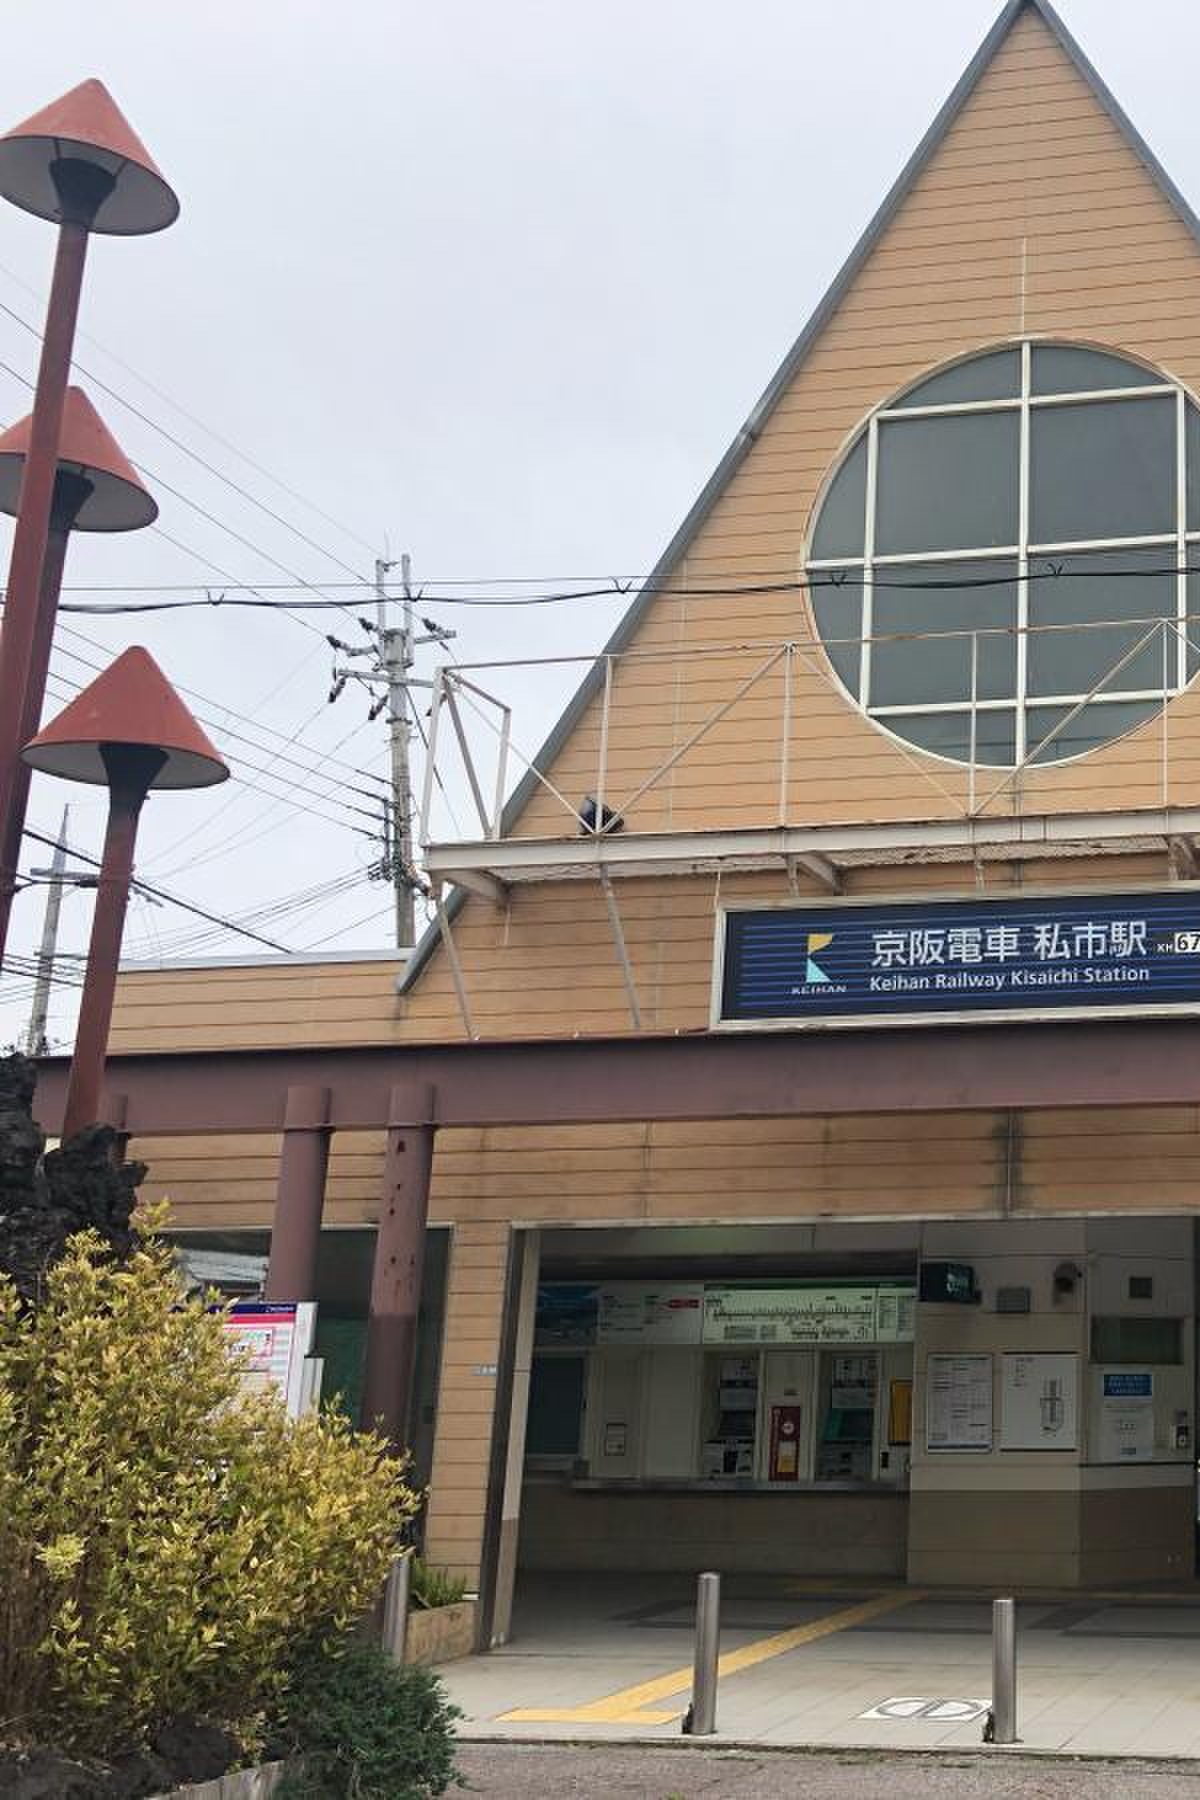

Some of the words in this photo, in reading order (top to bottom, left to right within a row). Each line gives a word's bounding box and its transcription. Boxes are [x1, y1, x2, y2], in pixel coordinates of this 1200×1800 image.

[871, 925, 1021, 967] 京阪電車
[1034, 920, 1147, 960] 私市駅
[791, 985, 847, 995] KEIHAN
[869, 975, 930, 992] Keihan
[935, 971, 1005, 989] Railway
[1011, 967, 1078, 985] Kisaichi
[1085, 965, 1149, 983] Station
